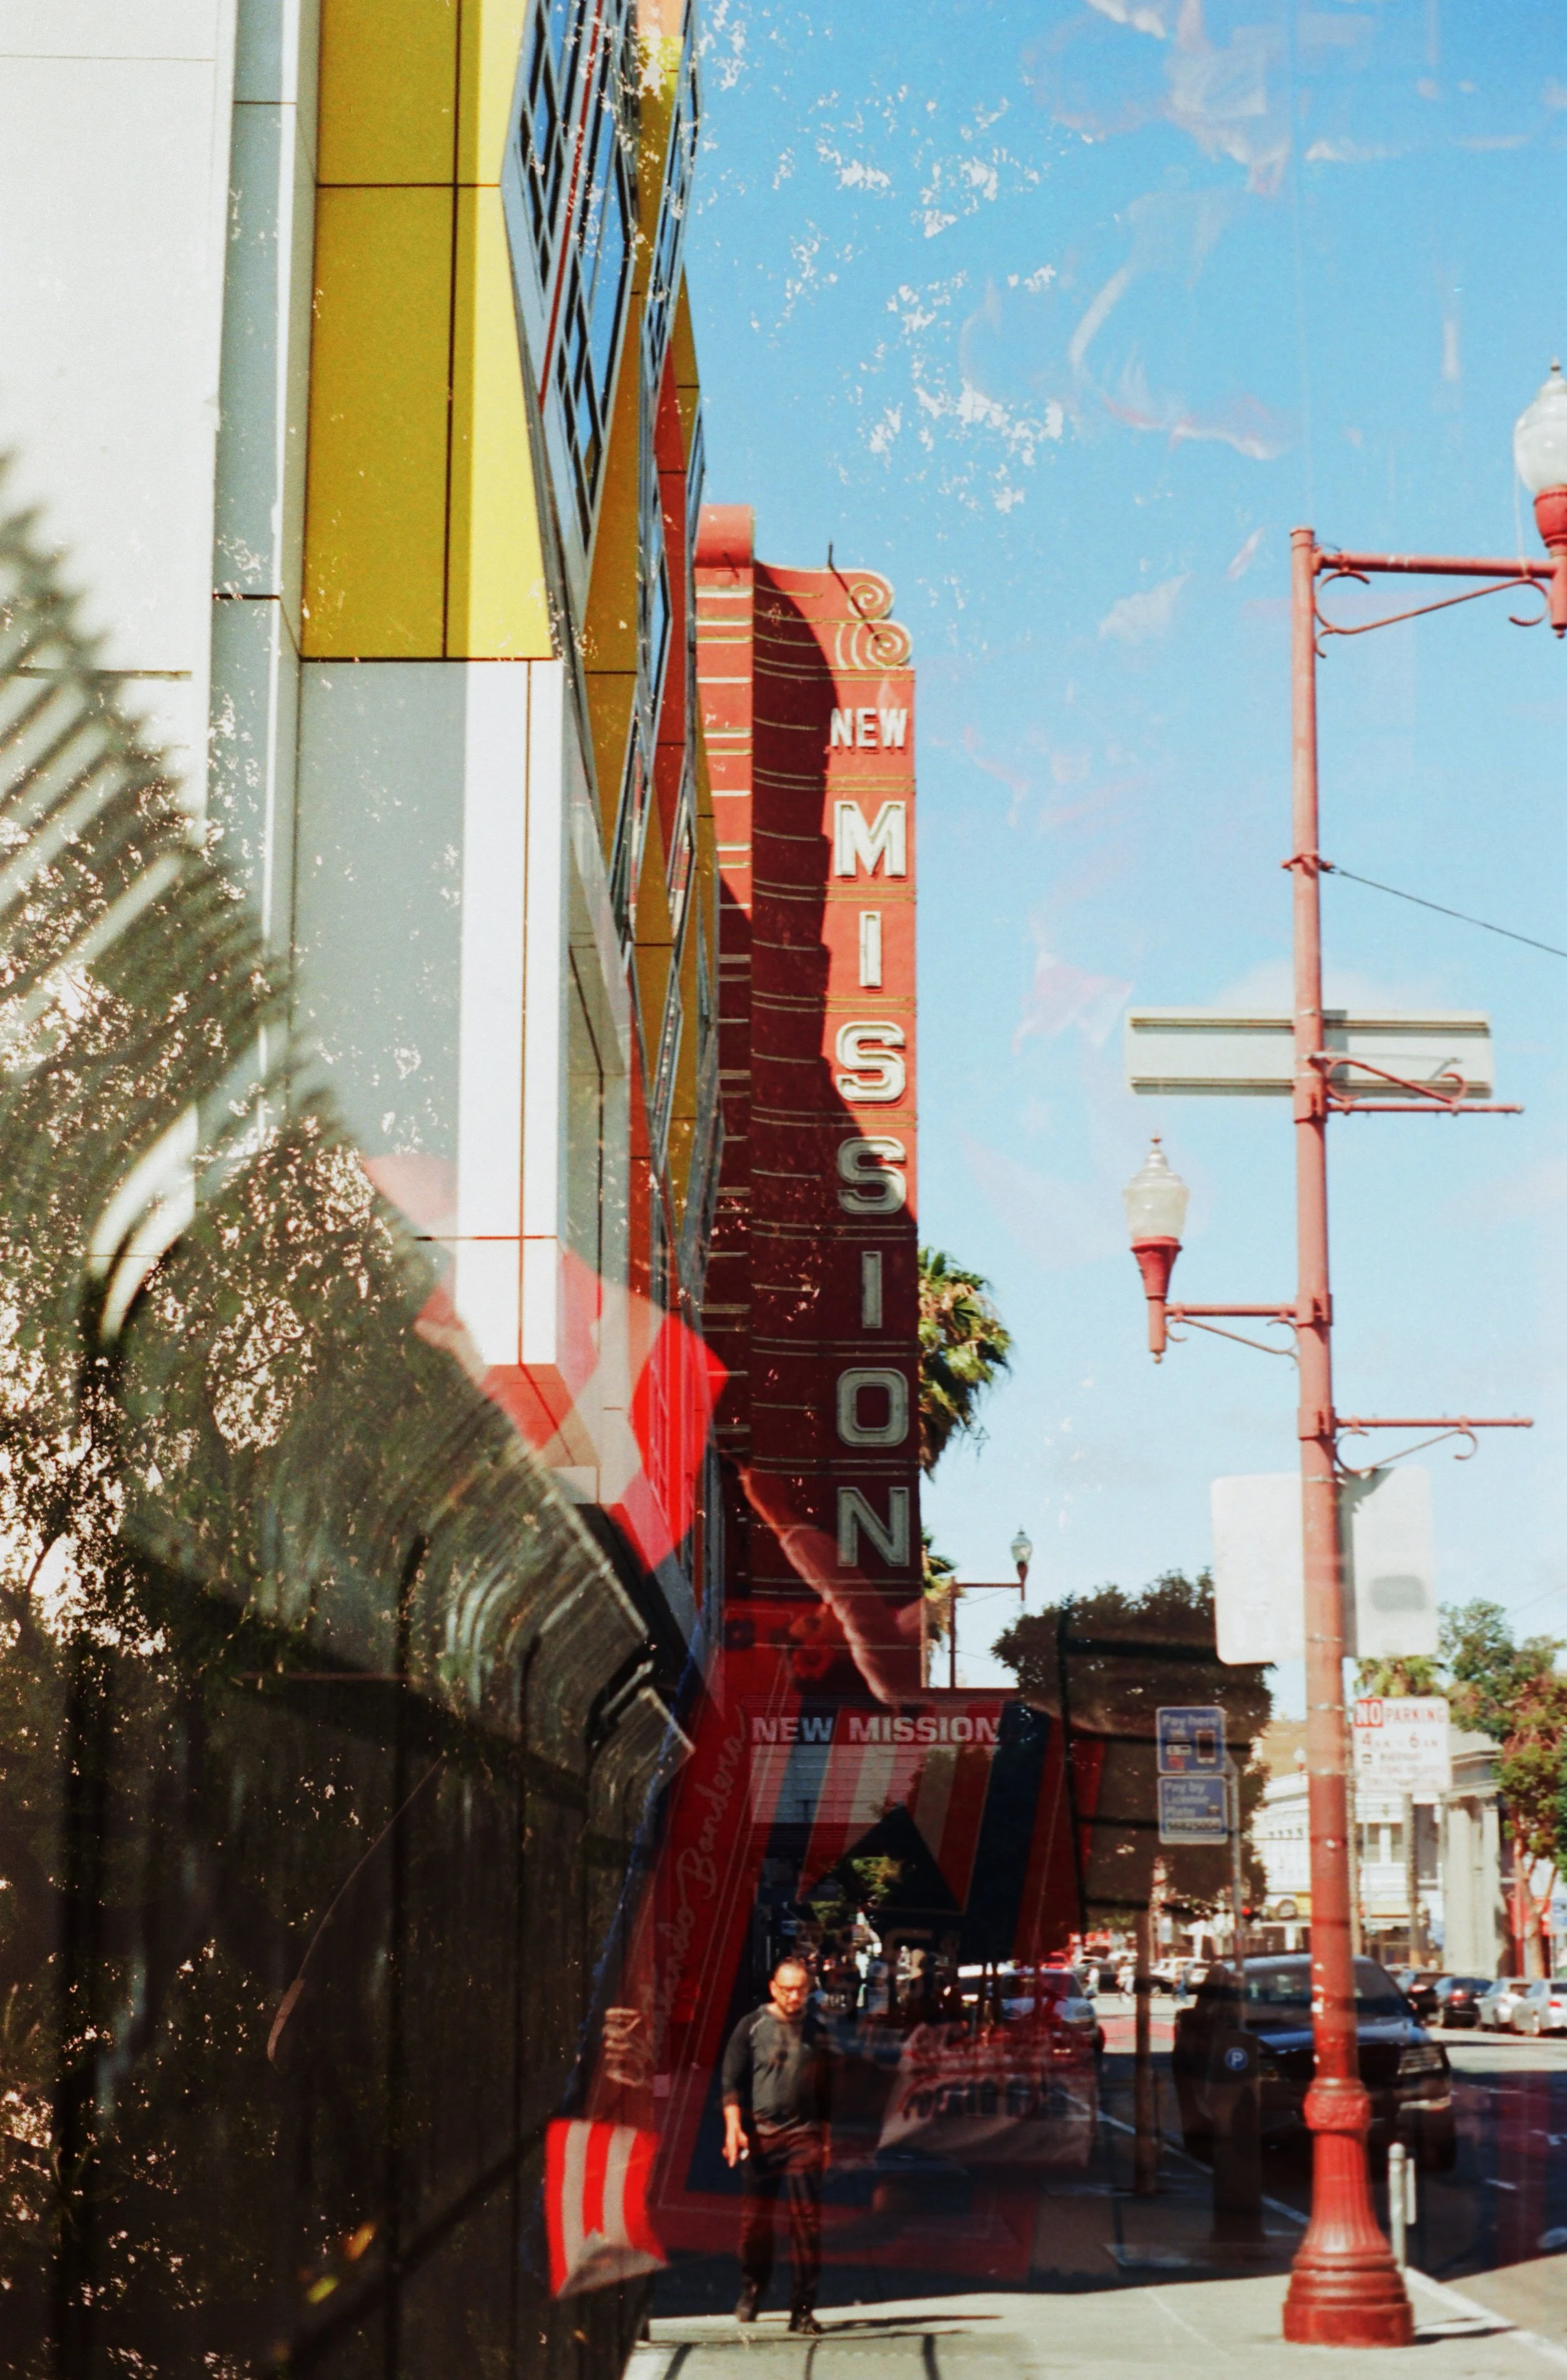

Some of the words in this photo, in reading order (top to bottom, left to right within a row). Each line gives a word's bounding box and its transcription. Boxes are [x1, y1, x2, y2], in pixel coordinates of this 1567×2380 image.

[831, 708, 907, 748] NEW
[832, 800, 910, 1567] MISSION
[1163, 1714, 1186, 1730] Pay
[1188, 1714, 1219, 1727] here
[1355, 1702, 1382, 1724] NO
[1385, 1706, 1446, 1724] PARKING
[752, 1716, 834, 1743] NEW
[849, 1716, 1000, 1743] MISSION
[1164, 1781, 1187, 1795] Pay
[1188, 1781, 1206, 1795] by
[1231, 2052, 1244, 2067] P
